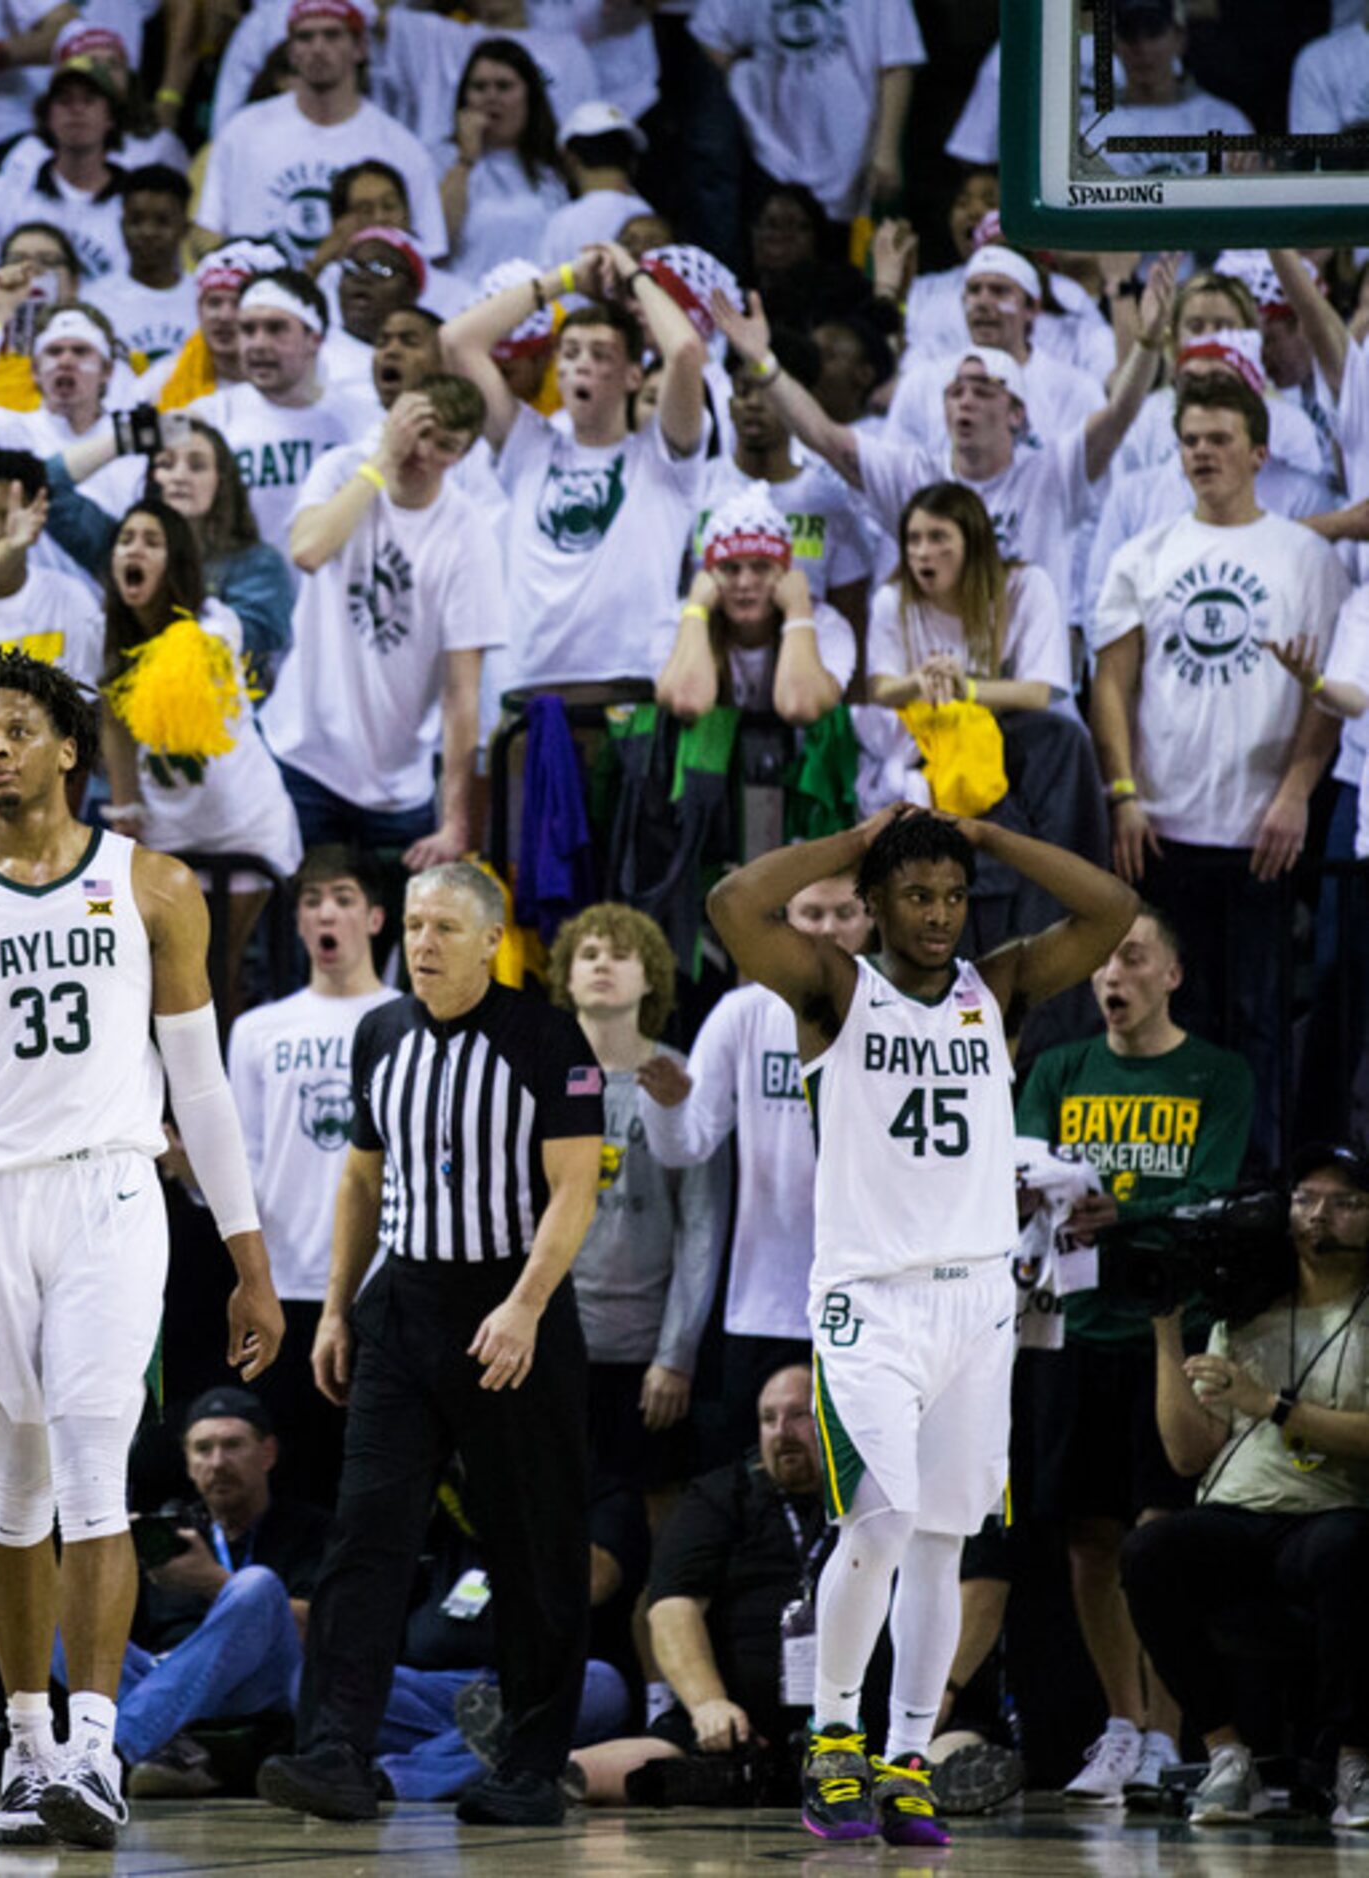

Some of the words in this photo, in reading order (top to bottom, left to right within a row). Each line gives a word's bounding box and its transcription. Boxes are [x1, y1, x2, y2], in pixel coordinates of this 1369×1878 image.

[1068, 182, 1164, 206] SPALDING
[234, 438, 336, 488] BAYL
[1165, 563, 1211, 602] LIVE
[1218, 560, 1270, 605] FROM
[10, 980, 91, 1061] 33
[275, 1036, 350, 1073] BAYL
[864, 1032, 991, 1077] BAYLOR
[888, 1087, 970, 1158] 45
[1059, 1092, 1202, 1146] BAYLOR
[819, 1291, 865, 1347] BU
